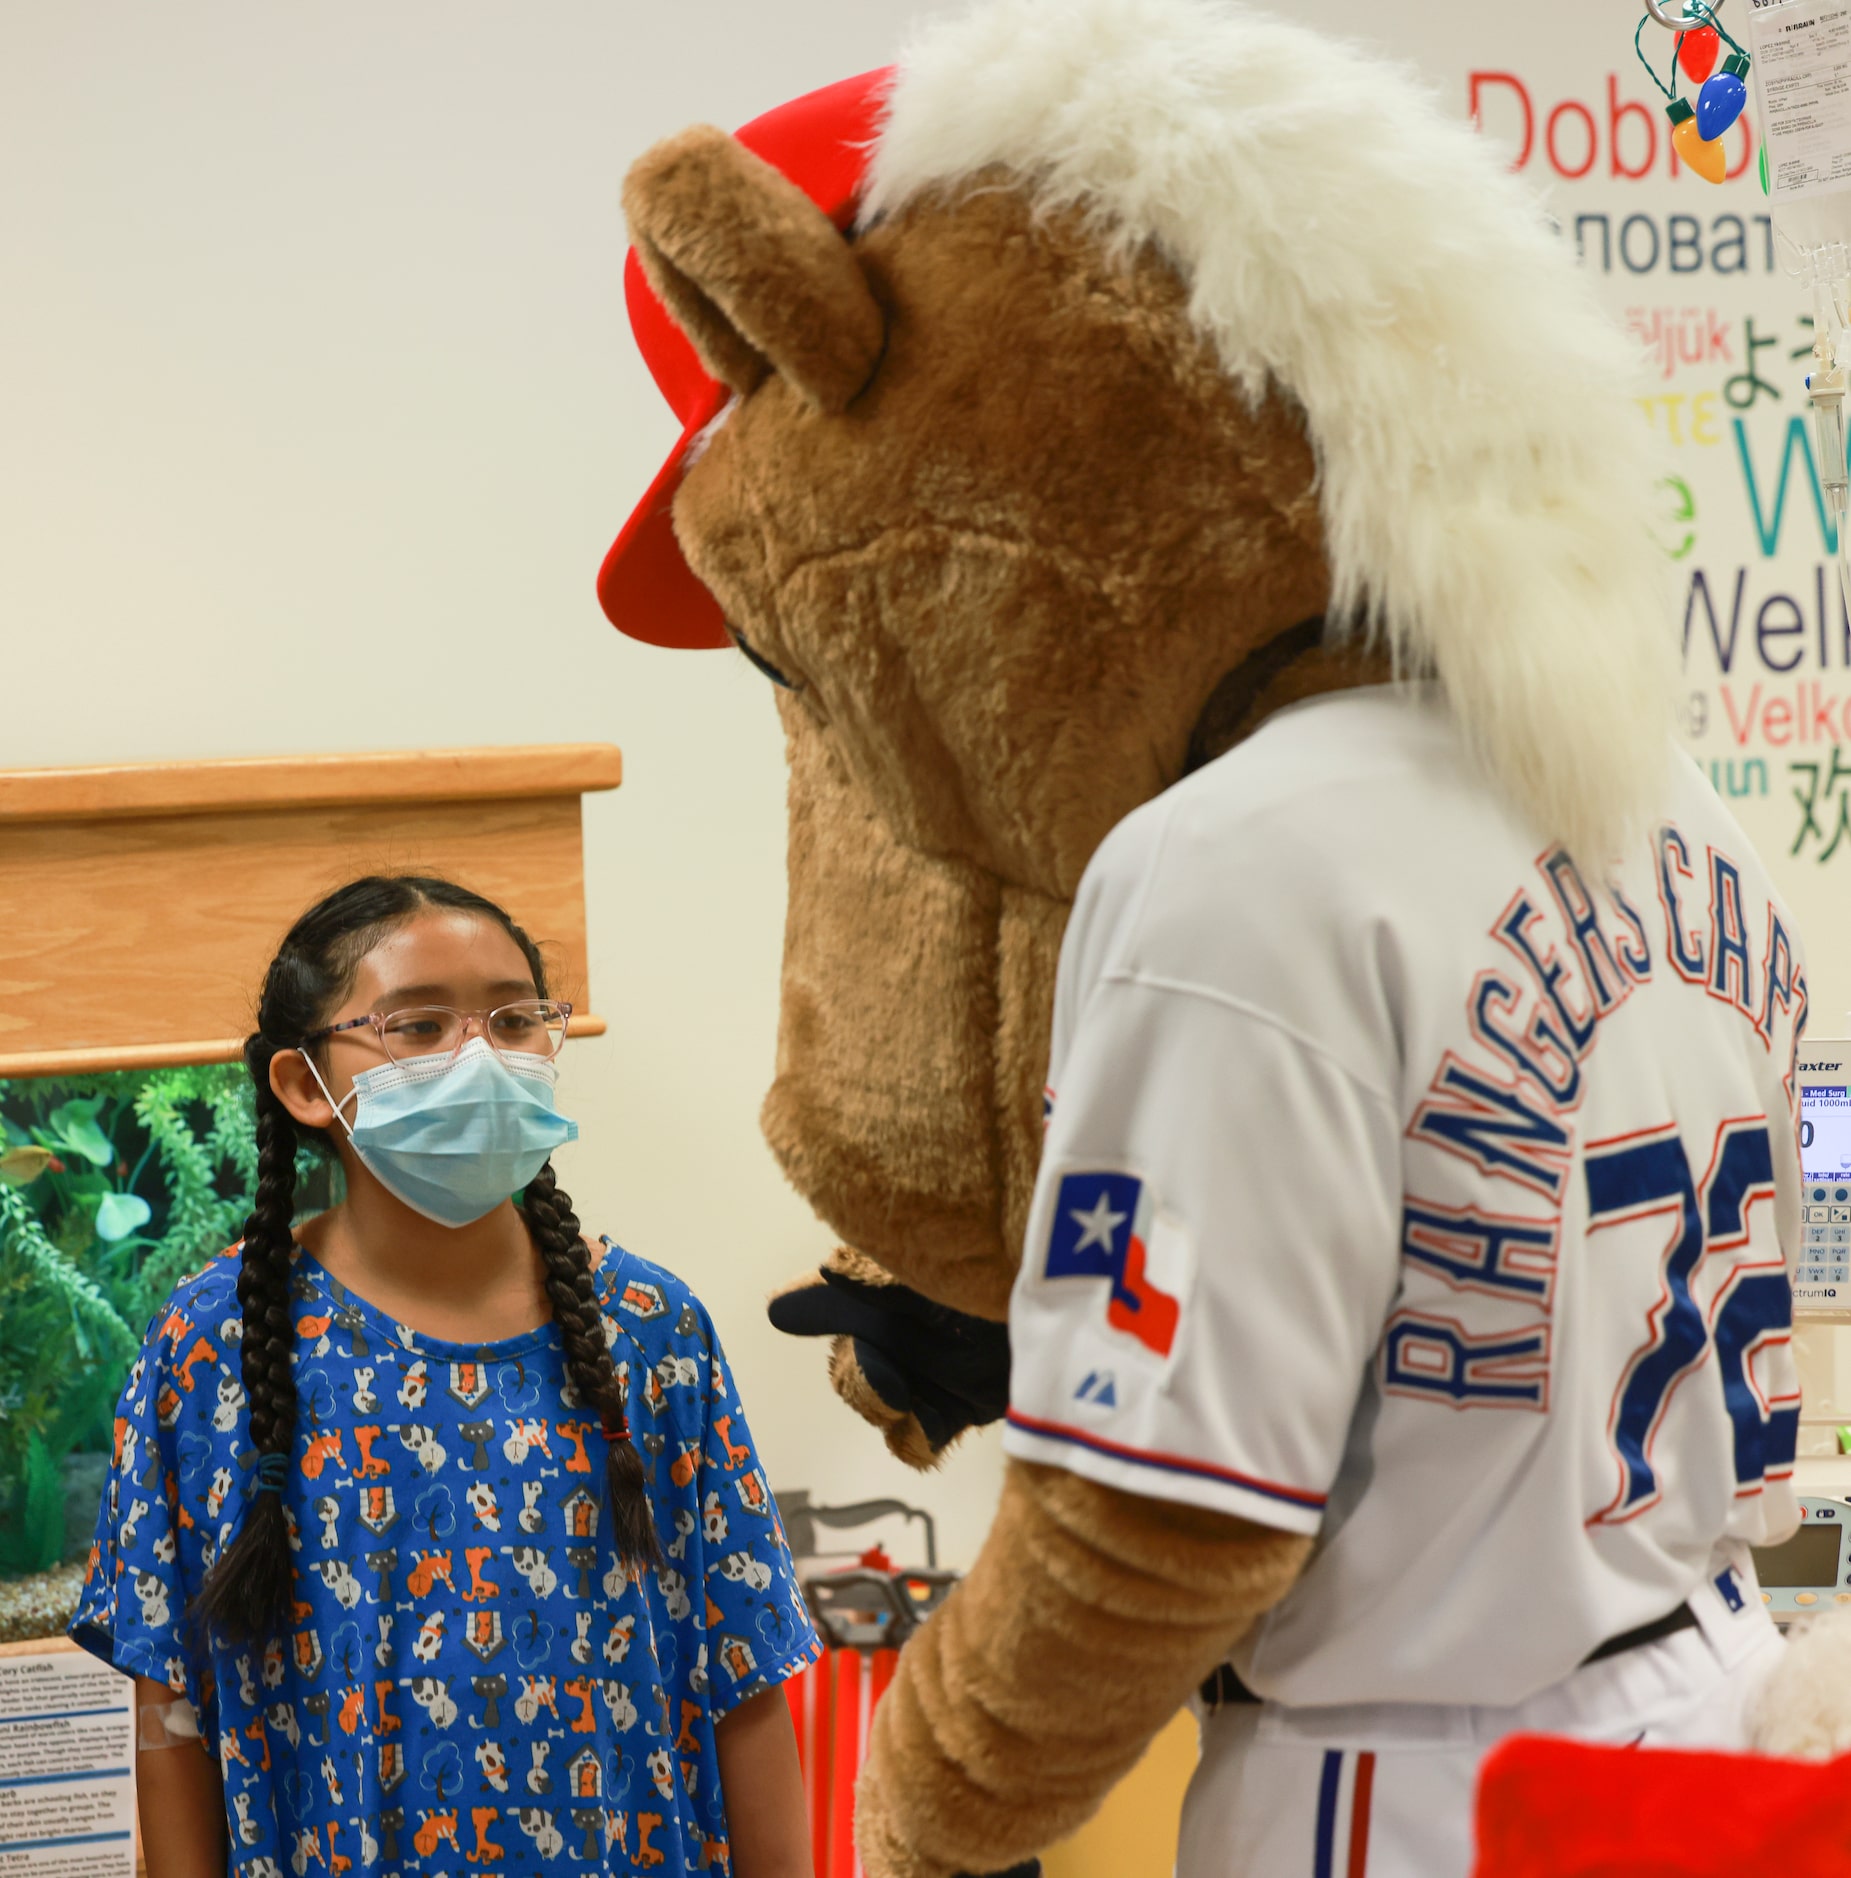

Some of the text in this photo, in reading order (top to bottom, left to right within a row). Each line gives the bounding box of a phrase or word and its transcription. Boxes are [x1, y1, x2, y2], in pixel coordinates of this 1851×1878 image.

[1799, 1062, 1842, 1071] axter
[1378, 838, 1653, 1415] RANGERS
[20, 1663, 54, 1674] Catfish
